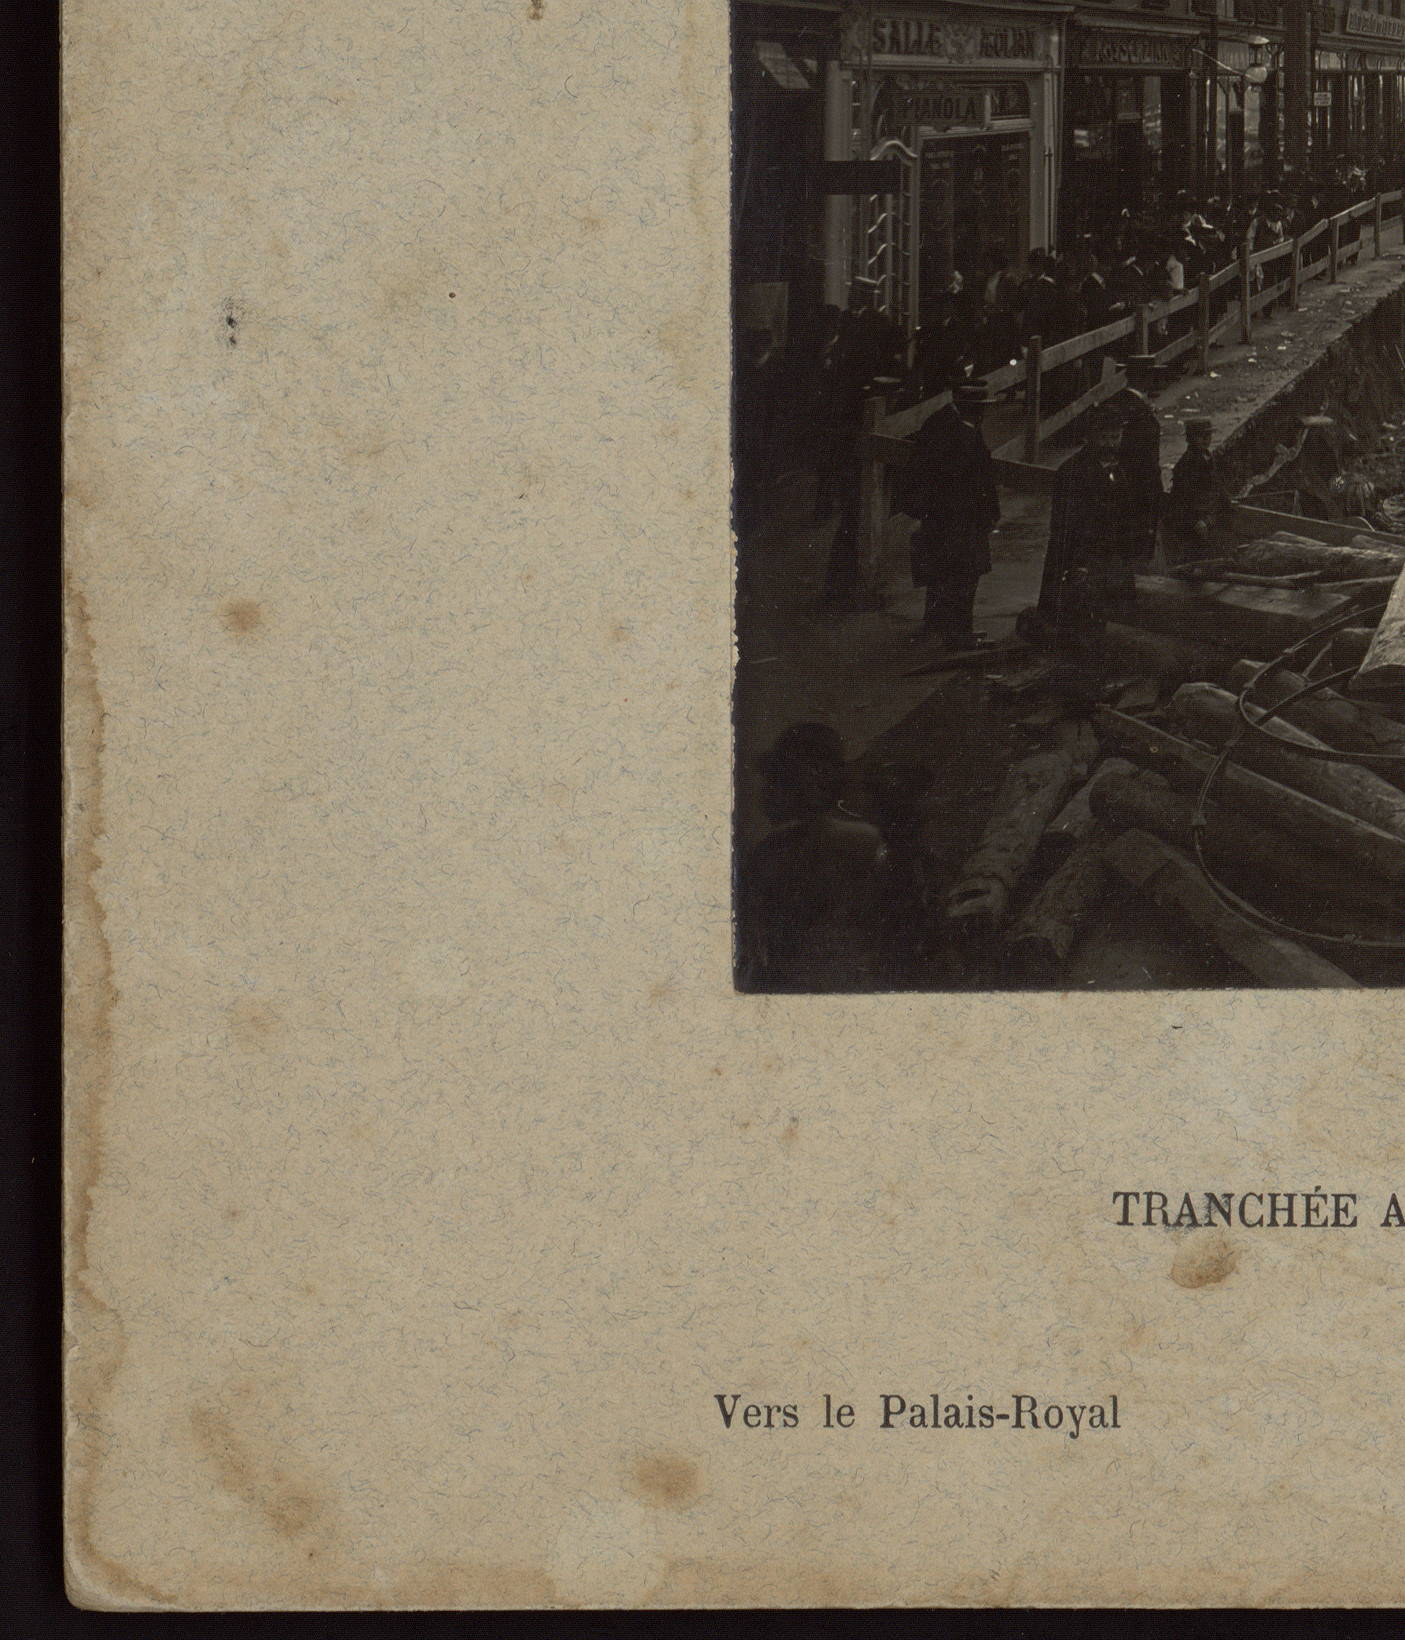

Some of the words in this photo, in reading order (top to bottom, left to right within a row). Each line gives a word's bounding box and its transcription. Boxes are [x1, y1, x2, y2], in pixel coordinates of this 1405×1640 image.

[1113, 1185, 1358, 1228] TRANCHÉE
[713, 1393, 800, 1430] Vers
[822, 1393, 856, 1429] le
[879, 1393, 1122, 1440] Palais-Royal
